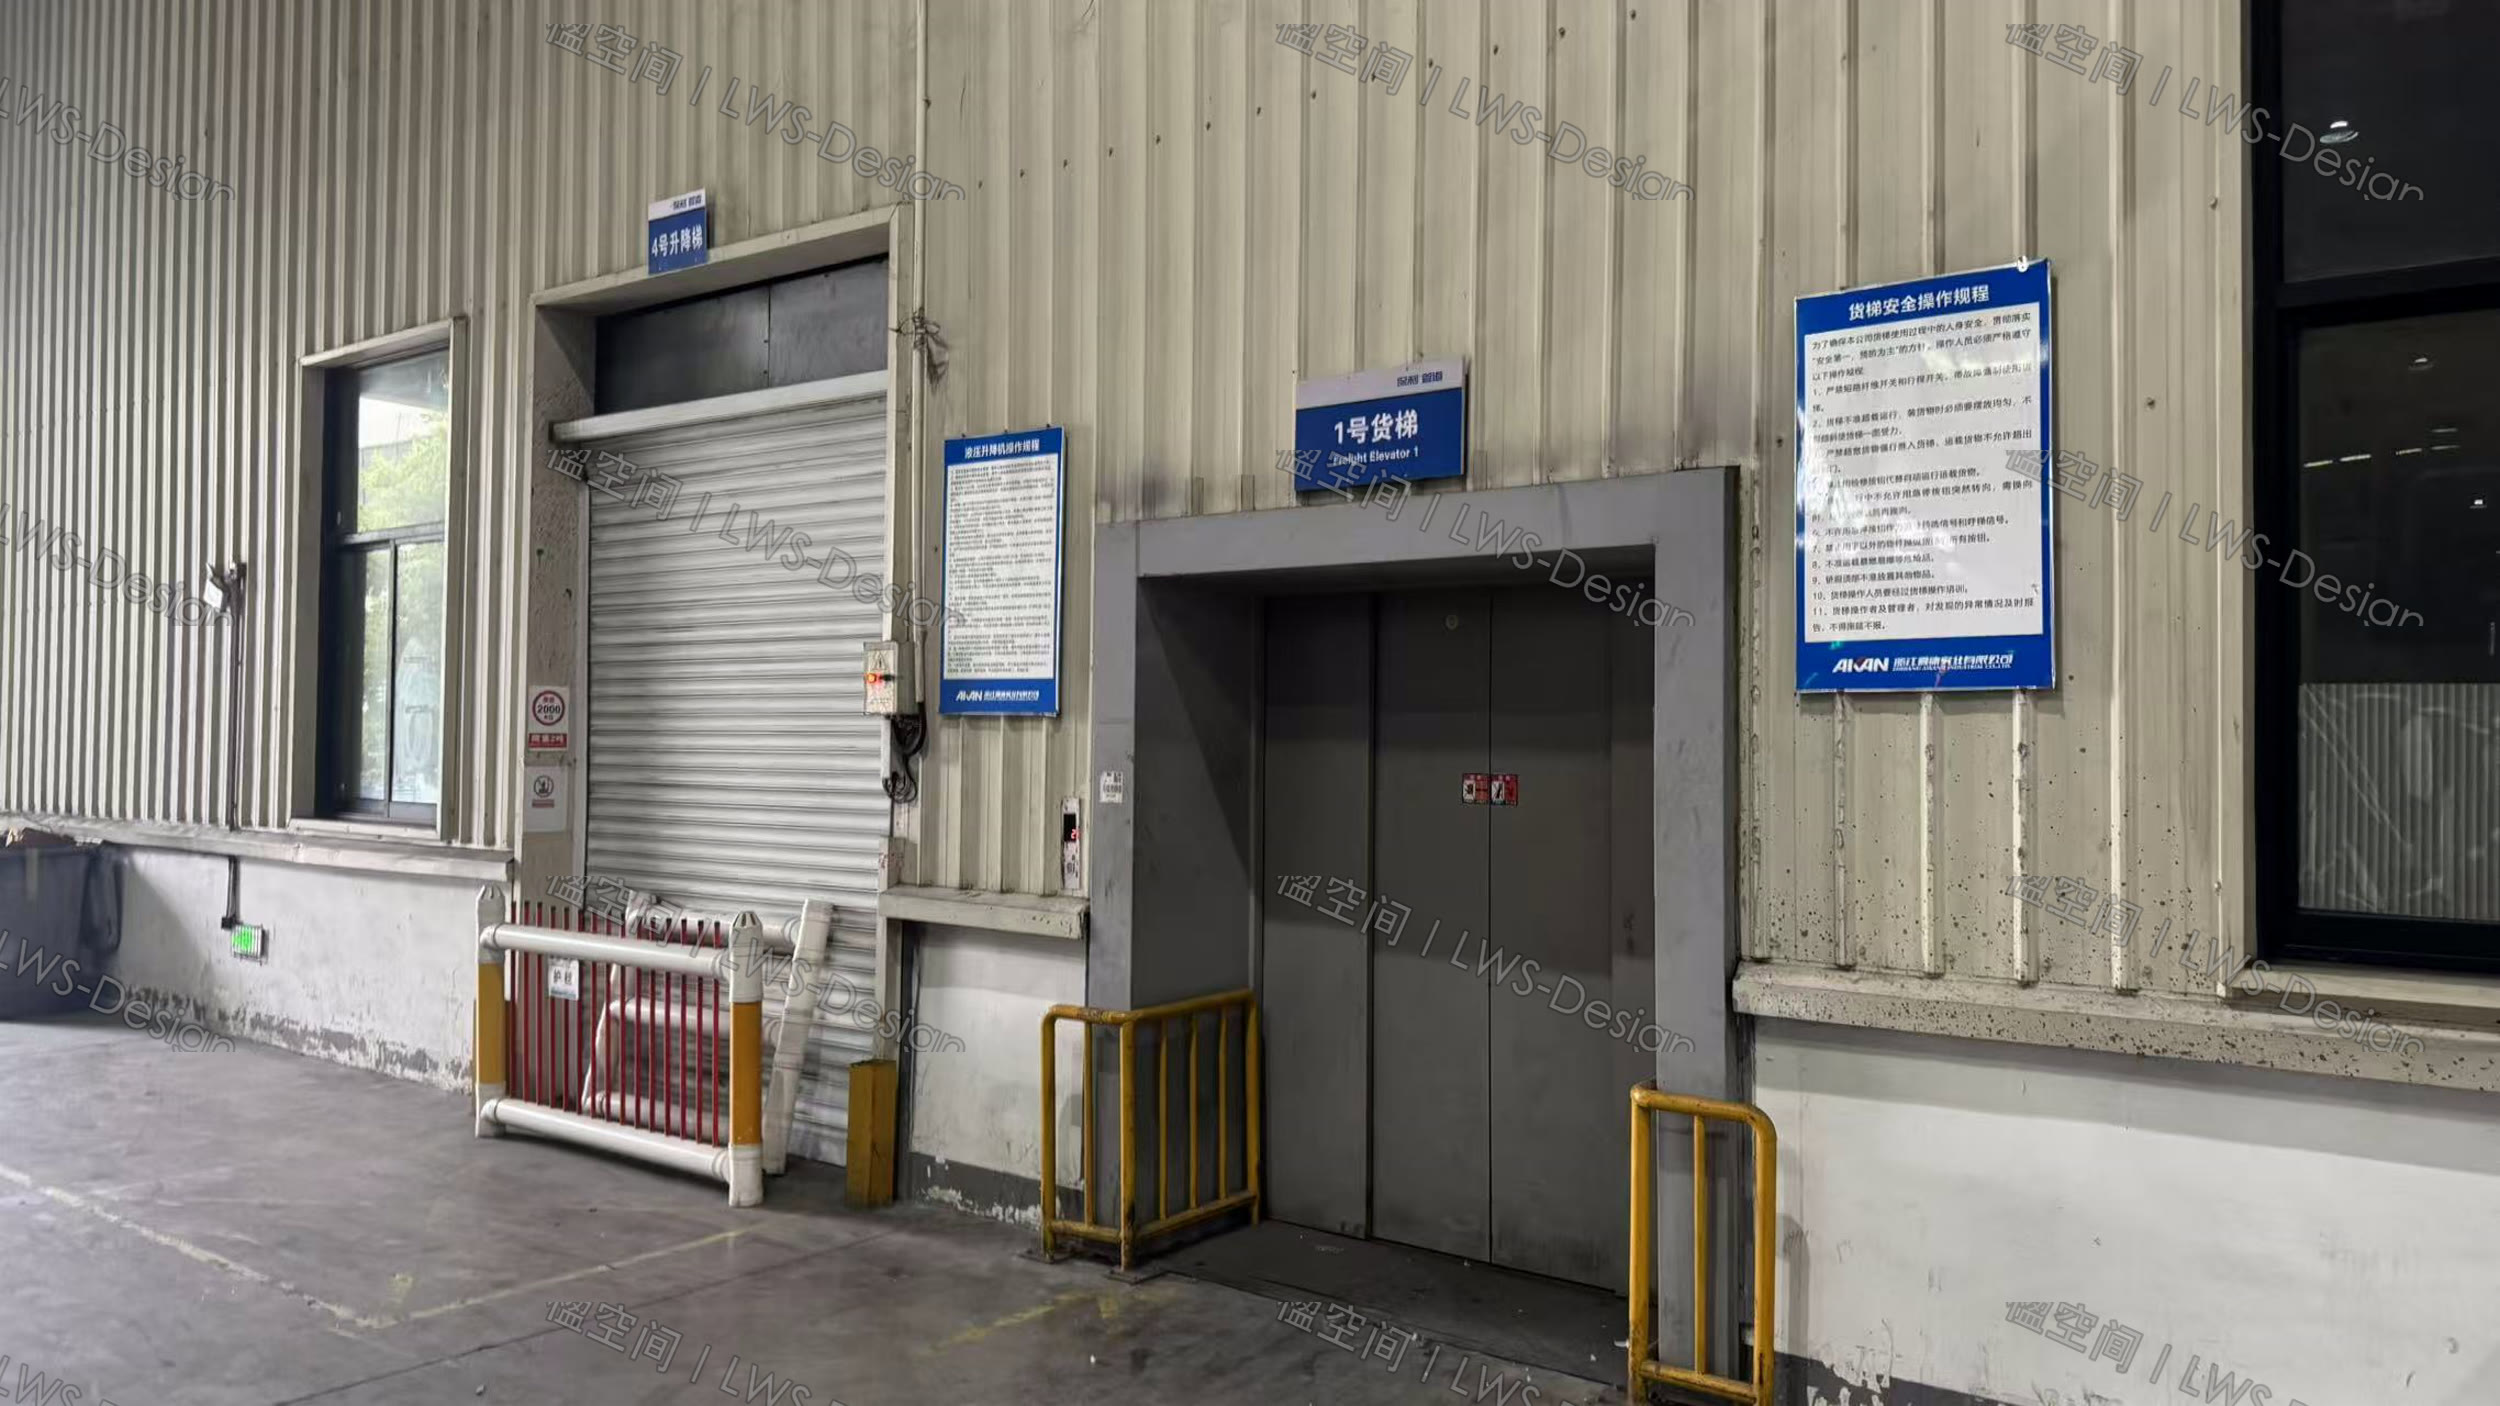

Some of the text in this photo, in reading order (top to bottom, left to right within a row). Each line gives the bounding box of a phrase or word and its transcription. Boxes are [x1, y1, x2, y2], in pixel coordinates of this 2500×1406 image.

[651, 224, 703, 257] 4号升降梯
[1848, 283, 1989, 321] 货梯安全操作规程
[1334, 408, 1418, 445] 1号货梯
[965, 438, 1040, 459] 液压升降机操作规程
[1369, 447, 1410, 462] Elevator
[1413, 445, 1419, 457] 1
[537, 704, 561, 714] 2000
